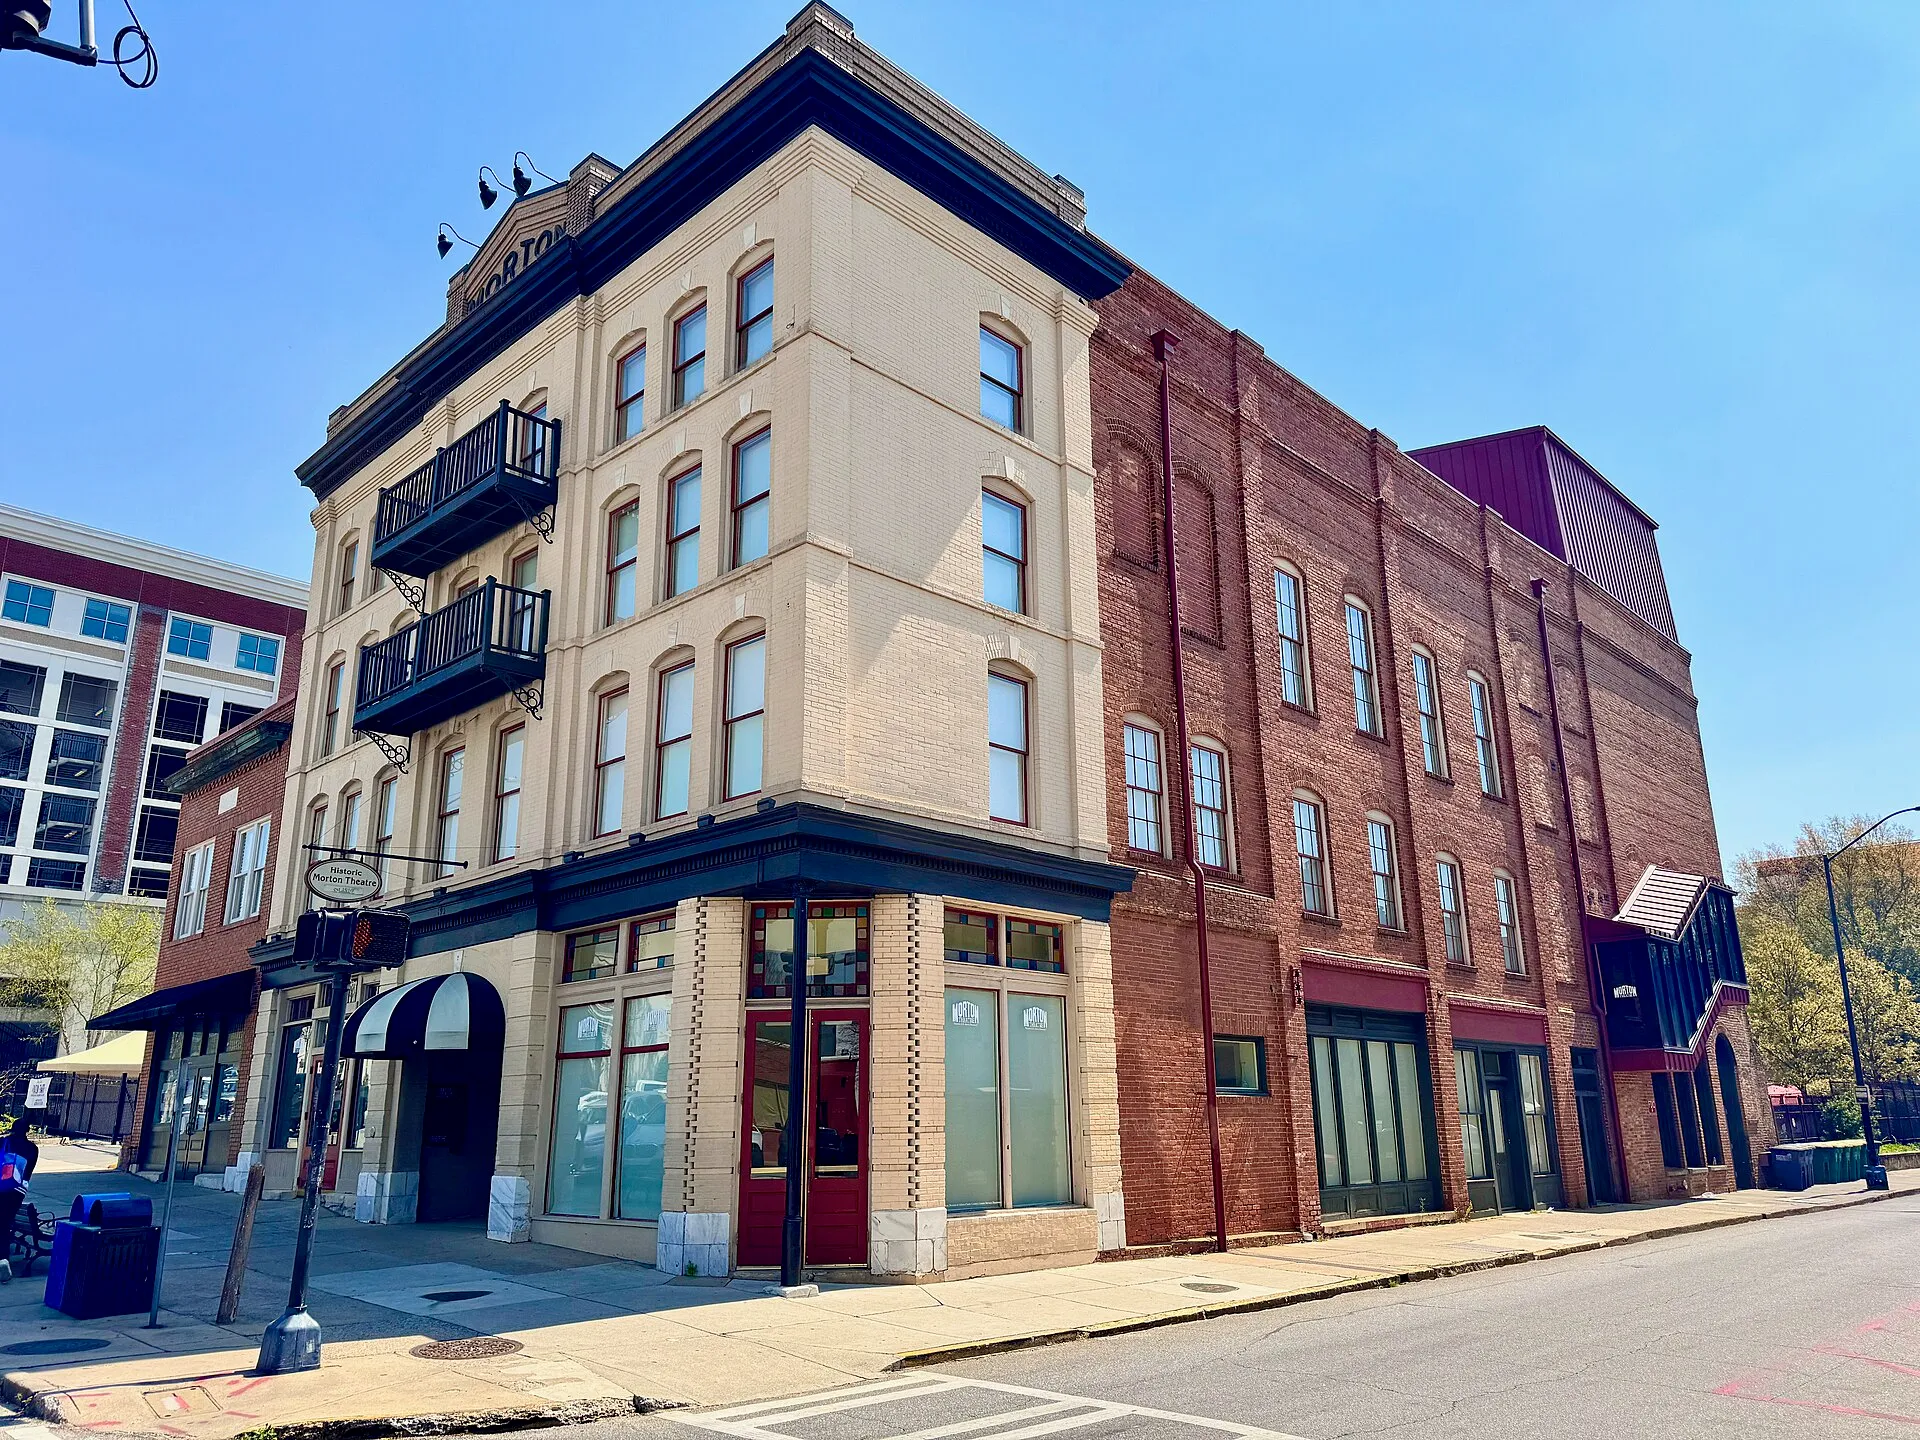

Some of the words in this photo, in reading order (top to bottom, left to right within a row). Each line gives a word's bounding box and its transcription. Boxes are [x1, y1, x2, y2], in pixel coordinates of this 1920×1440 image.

[330, 867, 362, 876] Historic
[312, 873, 343, 884] Morton
[345, 877, 377, 887] Theatre
[1613, 984, 1637, 998] MORTON
[952, 1000, 979, 1023] MORTON
[1023, 1006, 1048, 1029] MORTON
